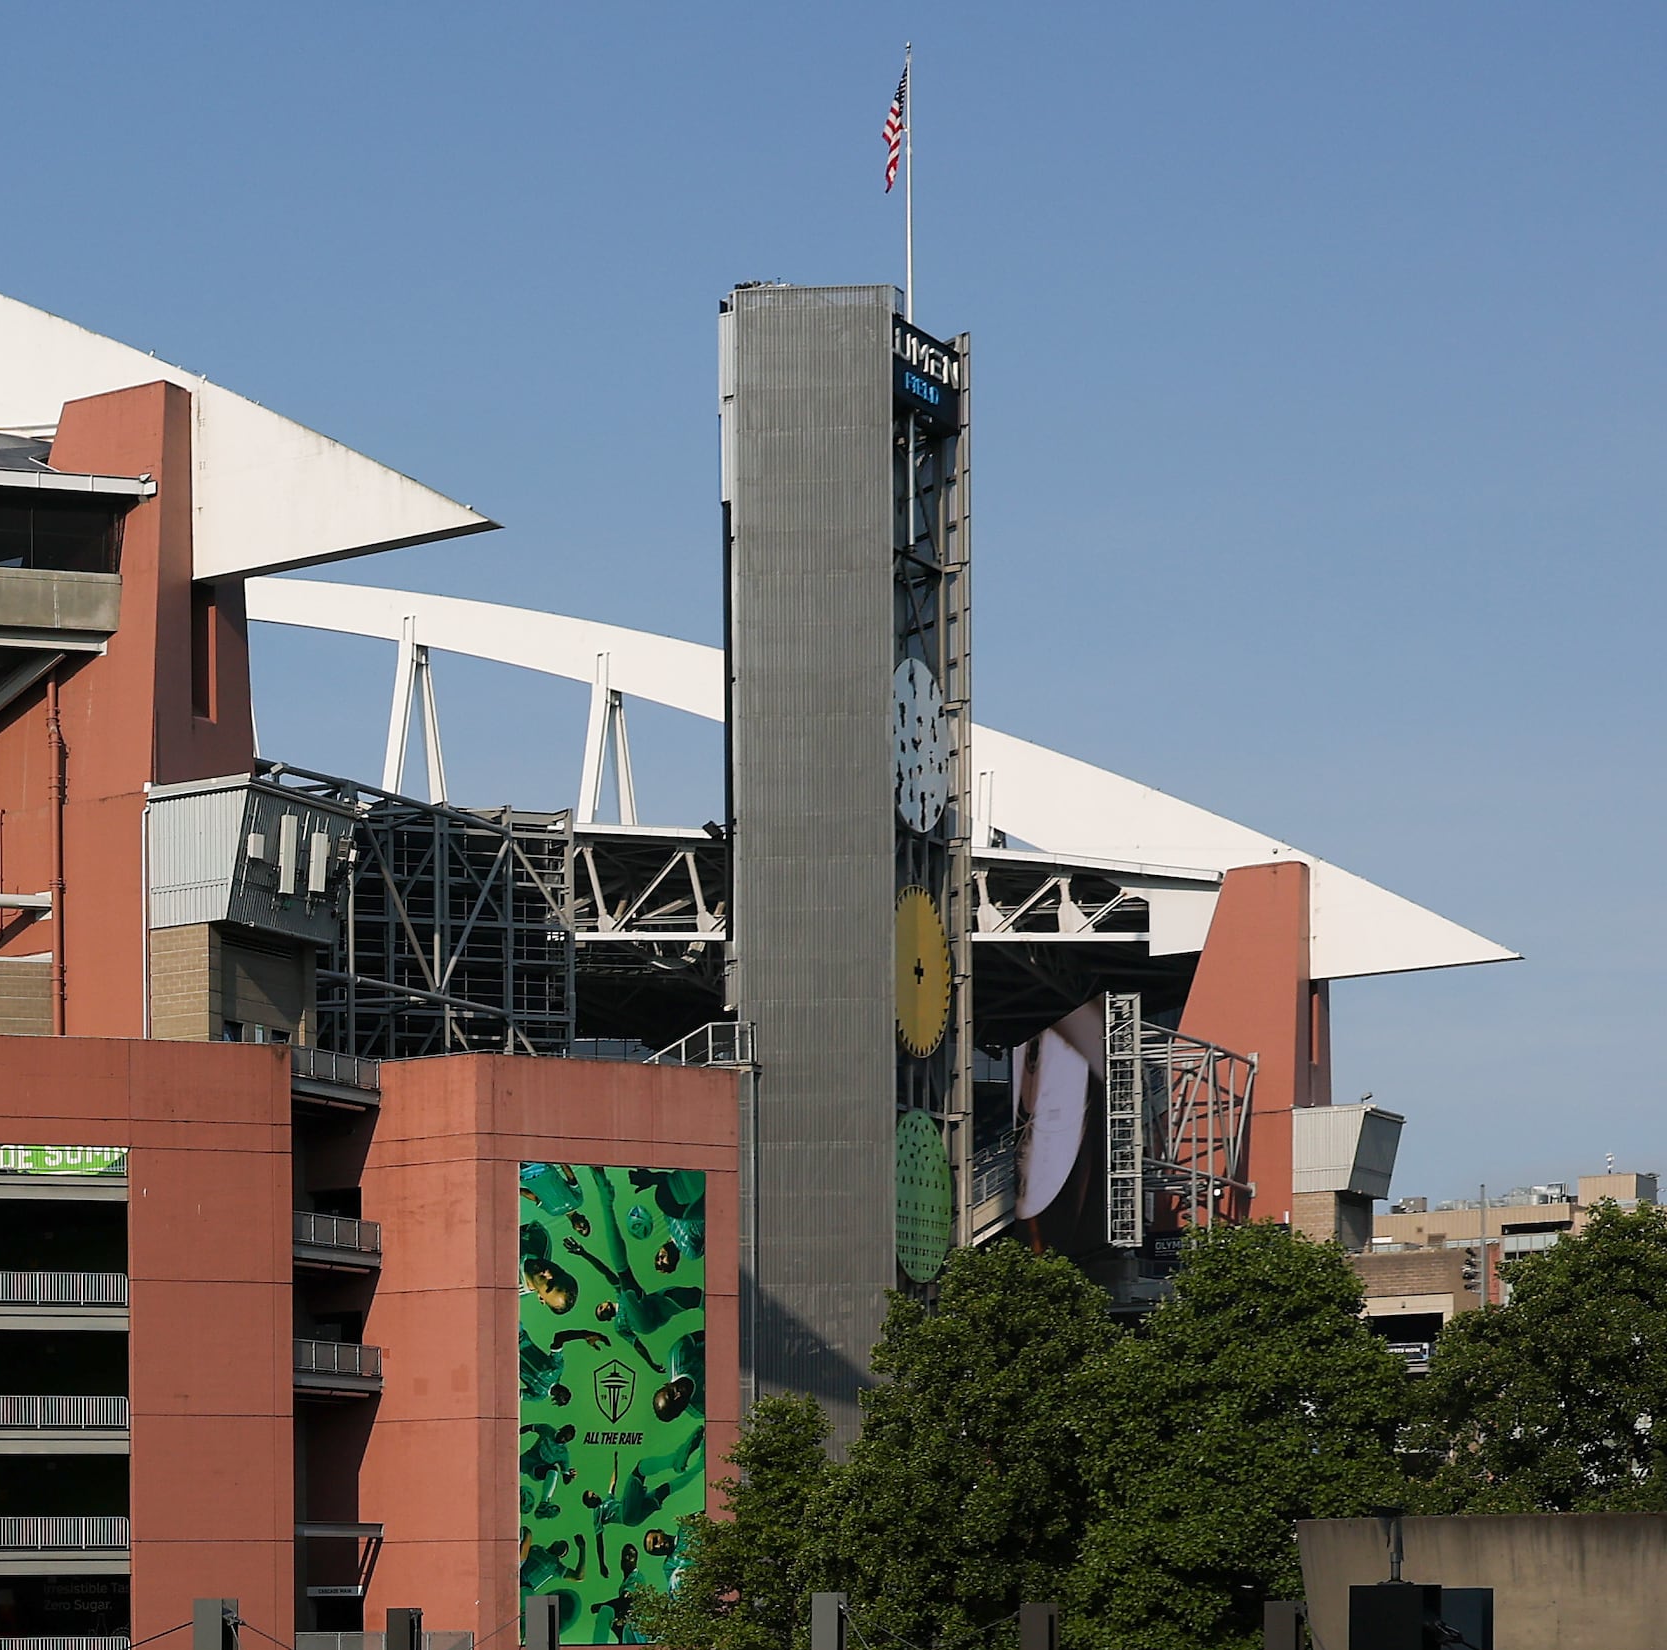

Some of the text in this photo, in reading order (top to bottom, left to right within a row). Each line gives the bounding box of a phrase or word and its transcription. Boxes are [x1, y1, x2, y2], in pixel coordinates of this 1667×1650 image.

[892, 326, 959, 391] UMEN
[903, 370, 939, 405] FIELD
[584, 1432, 643, 1445] ALL THE RAVE
[44, 1600, 71, 1611] Zero
